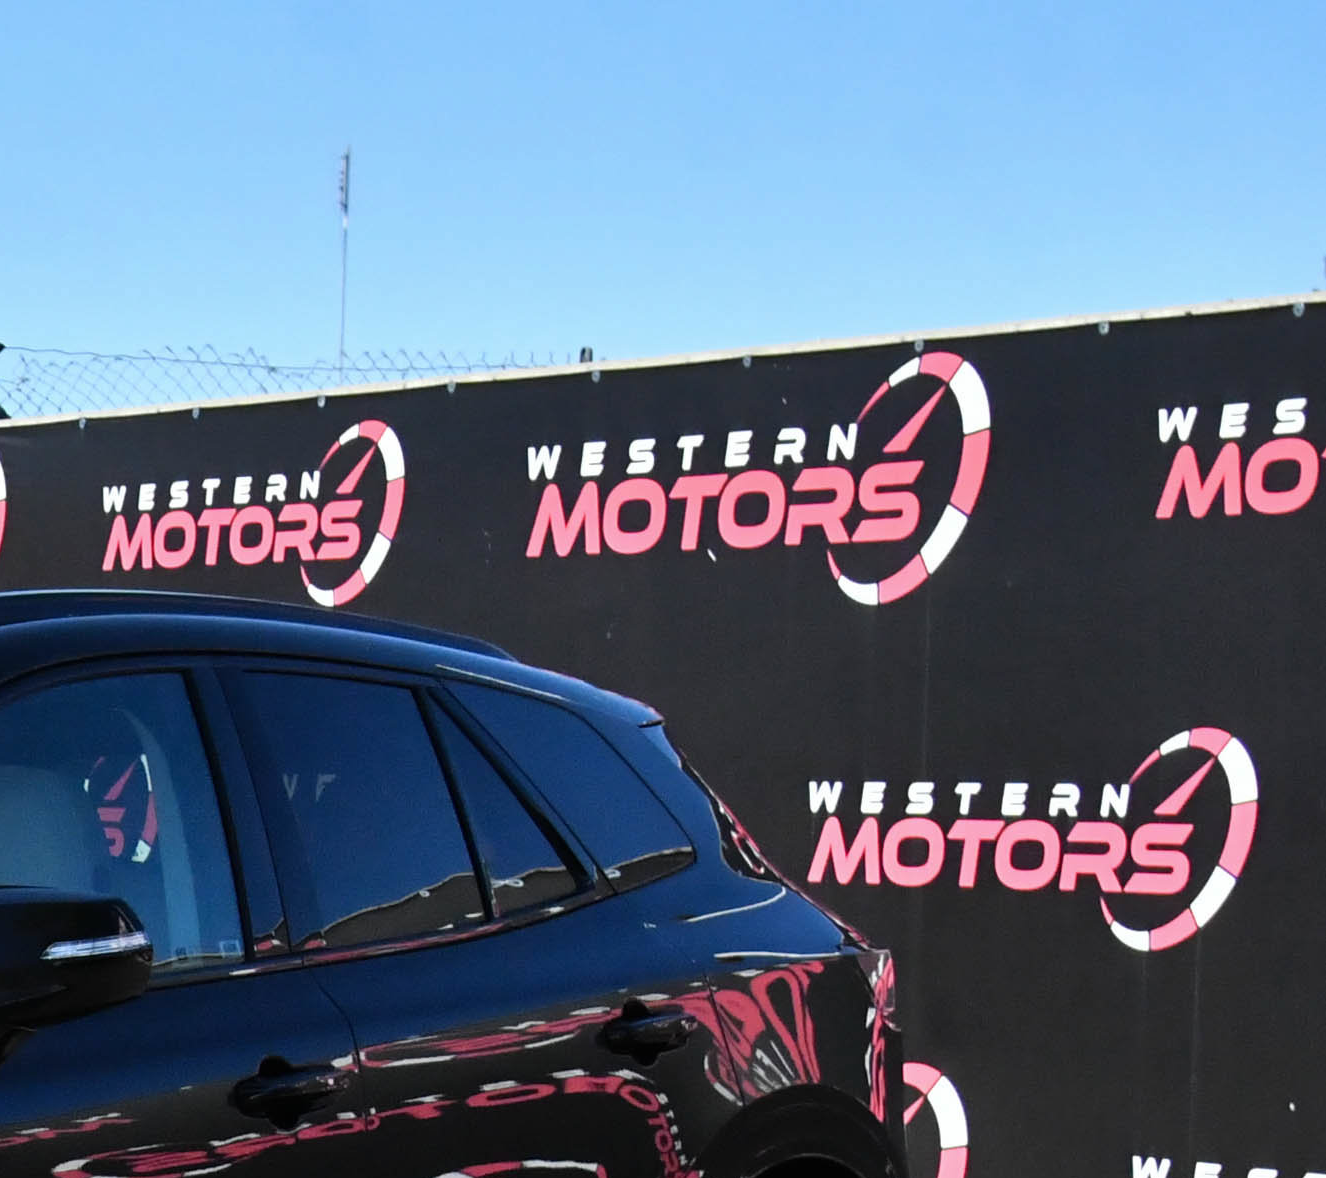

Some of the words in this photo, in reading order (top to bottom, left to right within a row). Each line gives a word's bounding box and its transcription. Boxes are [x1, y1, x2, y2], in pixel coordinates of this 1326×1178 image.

[528, 423, 858, 481] WESTERN
[1156, 436, 1326, 520] MO
[103, 470, 320, 513] WESTERN
[525, 459, 925, 557] MOTORS
[101, 497, 364, 571] MOTORS
[809, 781, 1130, 818] WESTERN
[808, 816, 1195, 893] MOTORS
